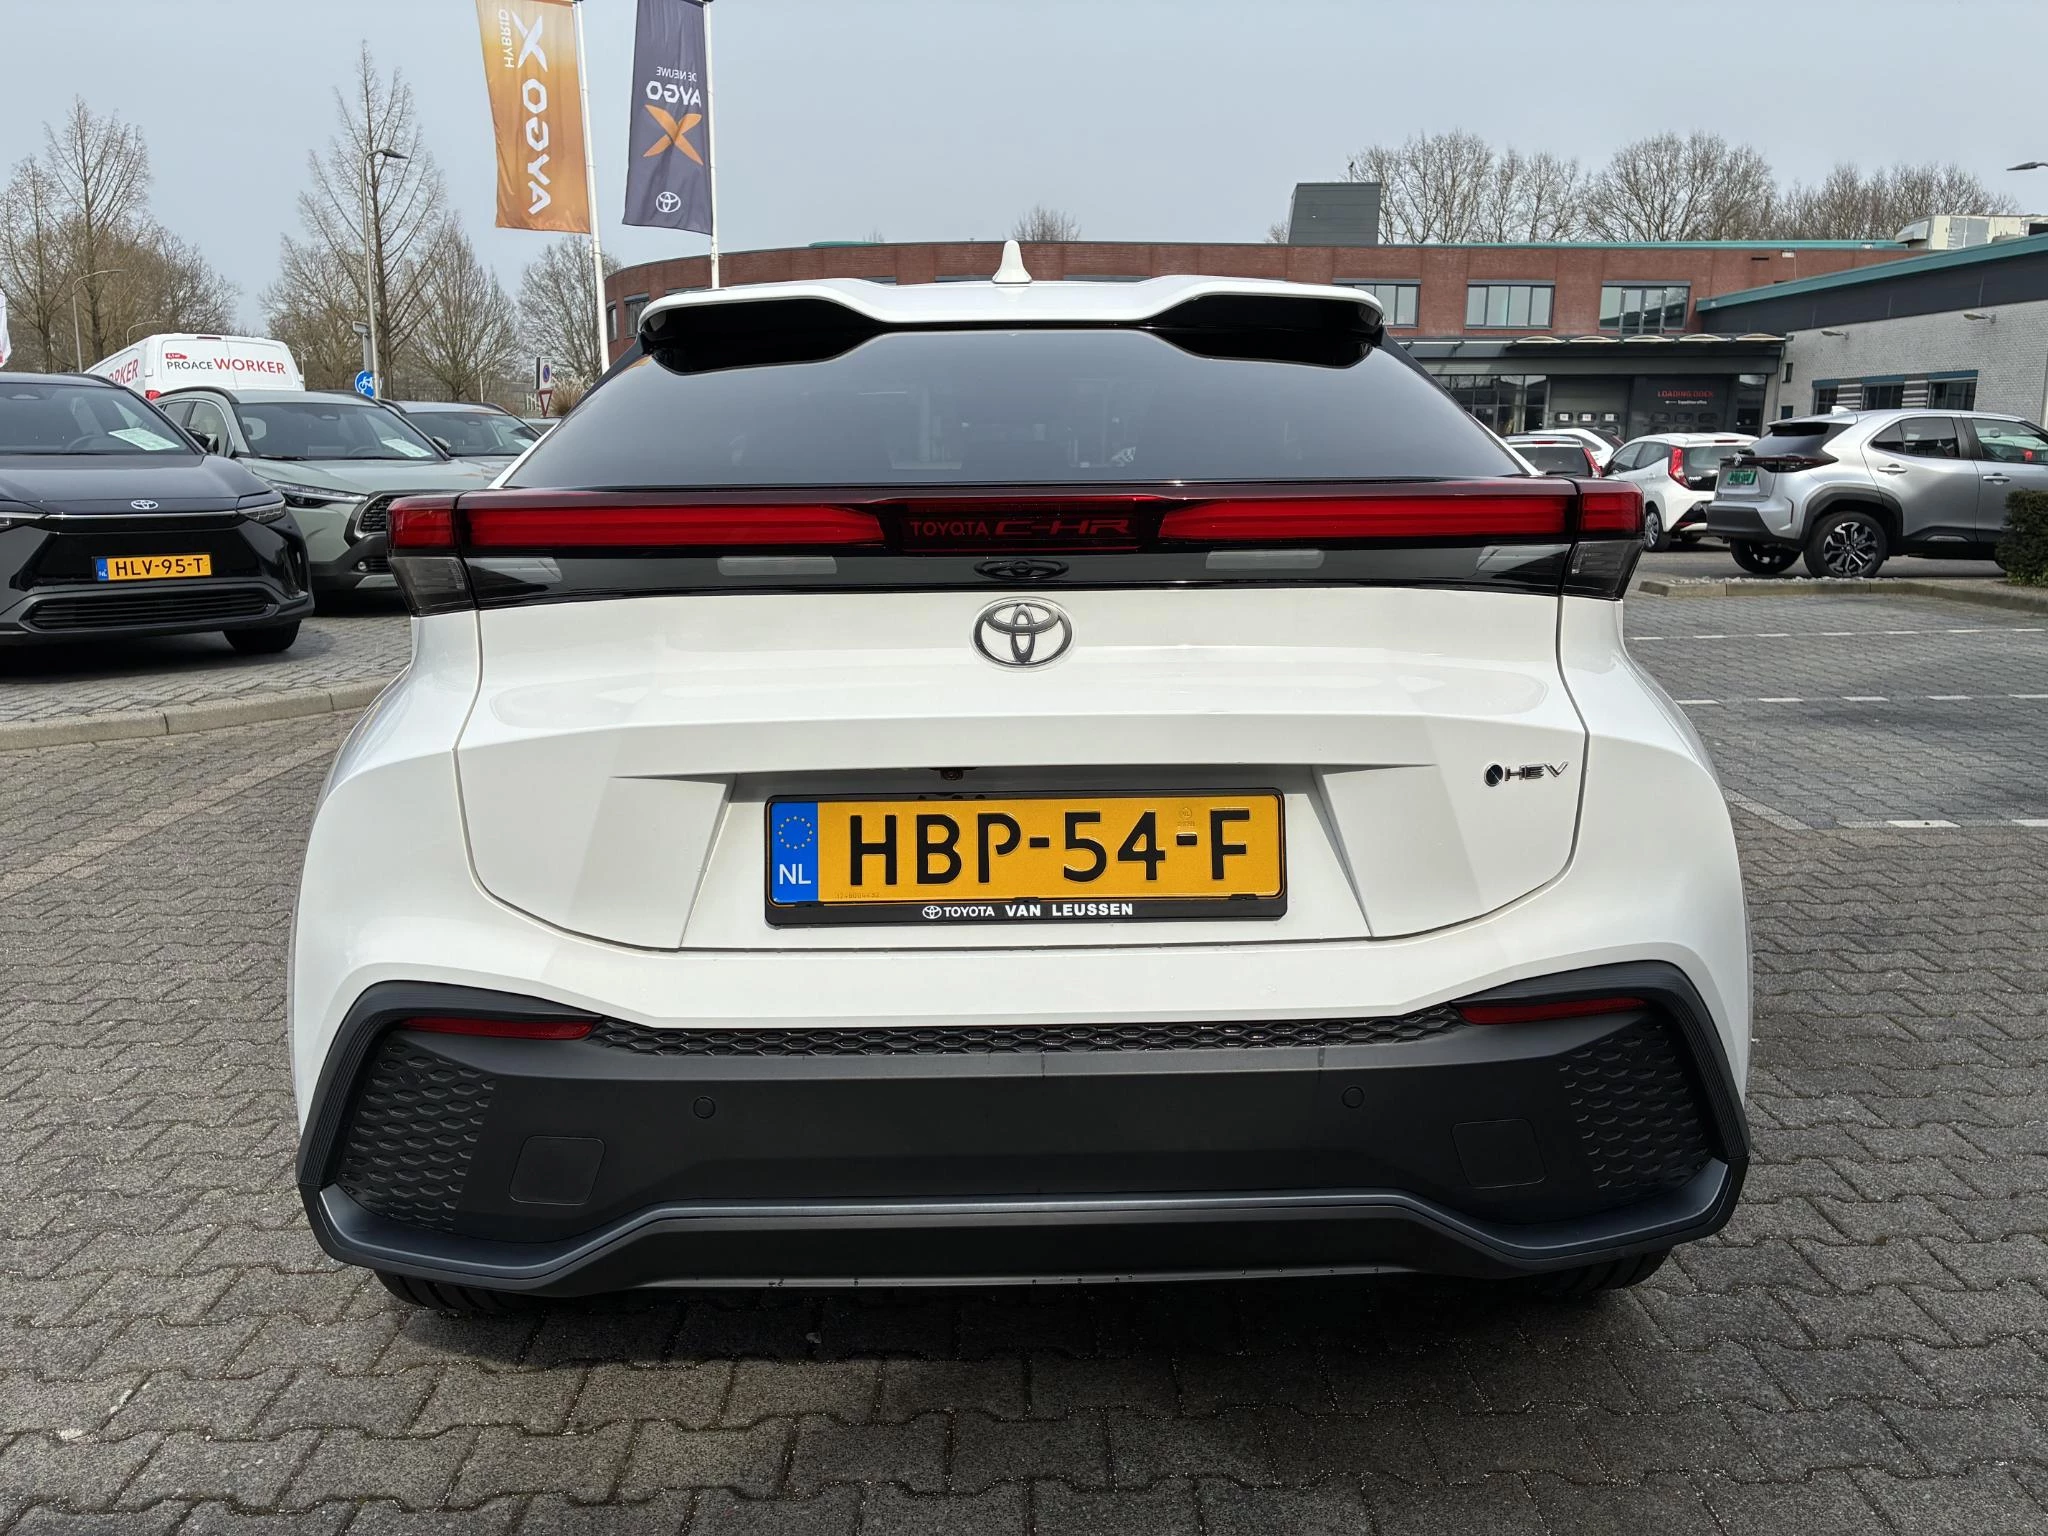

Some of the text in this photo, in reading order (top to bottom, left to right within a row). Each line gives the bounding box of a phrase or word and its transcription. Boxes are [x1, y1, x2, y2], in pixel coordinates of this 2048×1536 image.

[166, 358, 286, 374] PROACE WORKER
[911, 519, 1128, 536] TOYOTA C-HR
[115, 558, 203, 577] HLV-95-T
[1504, 760, 1568, 781] HEV
[779, 808, 1251, 886] NL HBP-54-F
[943, 903, 1133, 917] TOYOTA VAN LEUSSEN
